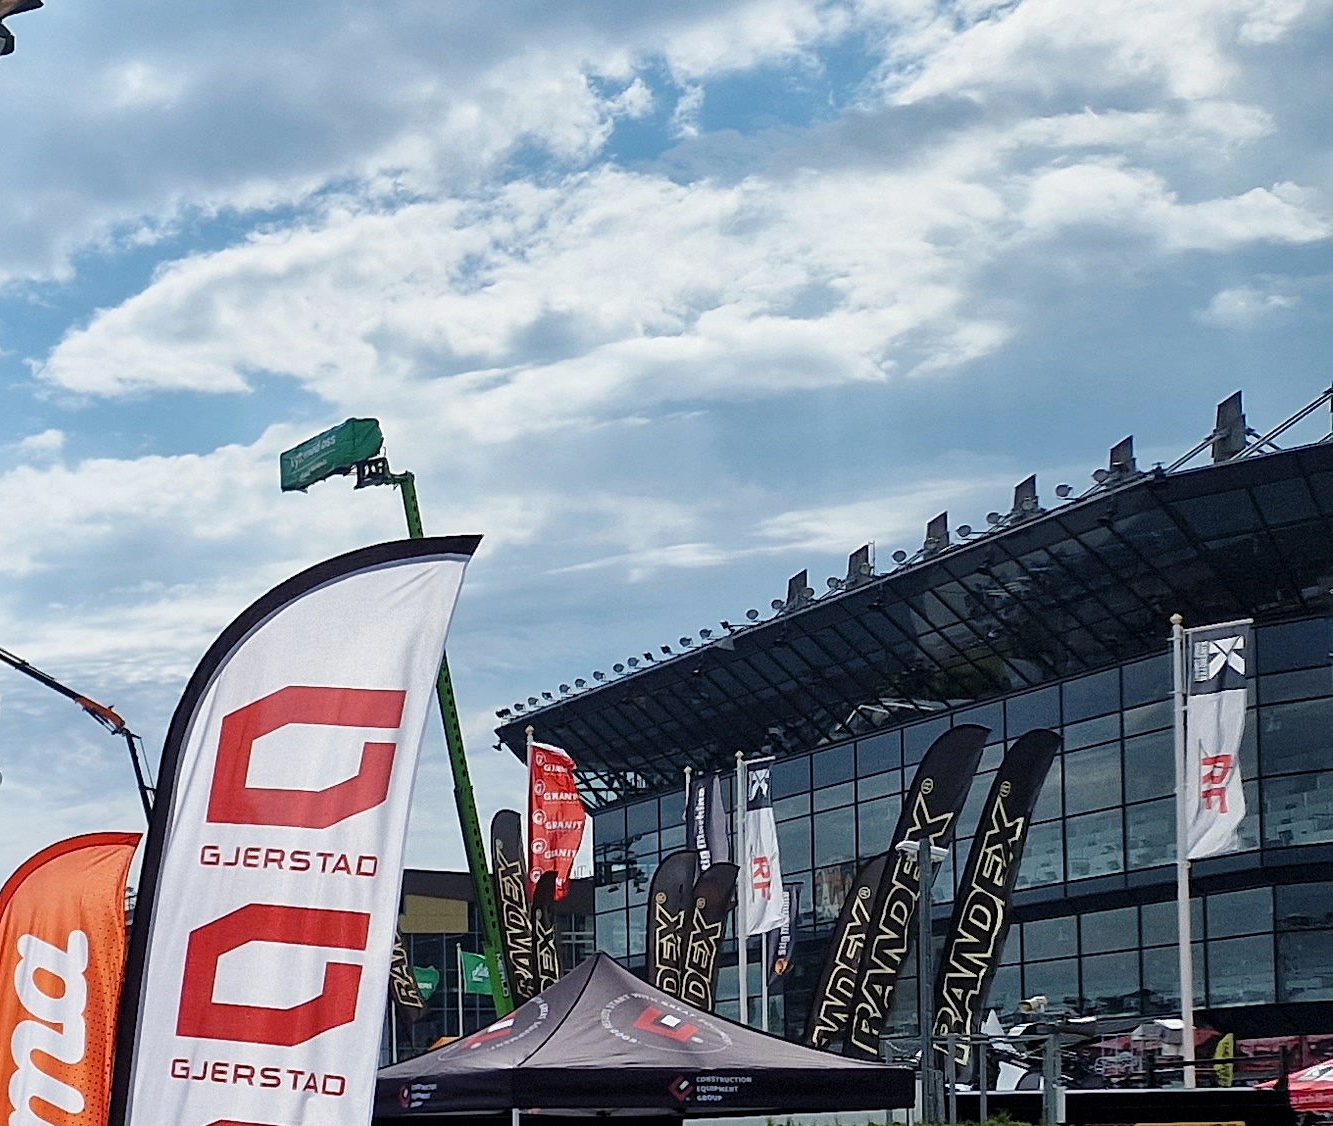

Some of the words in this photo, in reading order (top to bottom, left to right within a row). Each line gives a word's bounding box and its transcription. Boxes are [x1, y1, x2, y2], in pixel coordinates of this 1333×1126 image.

[544, 820, 584, 831] GRANIT
[199, 844, 379, 878] GJERSTAD
[170, 1058, 346, 1097] GJERSTAD
[695, 1076, 753, 1084] CONSTRUCTION
